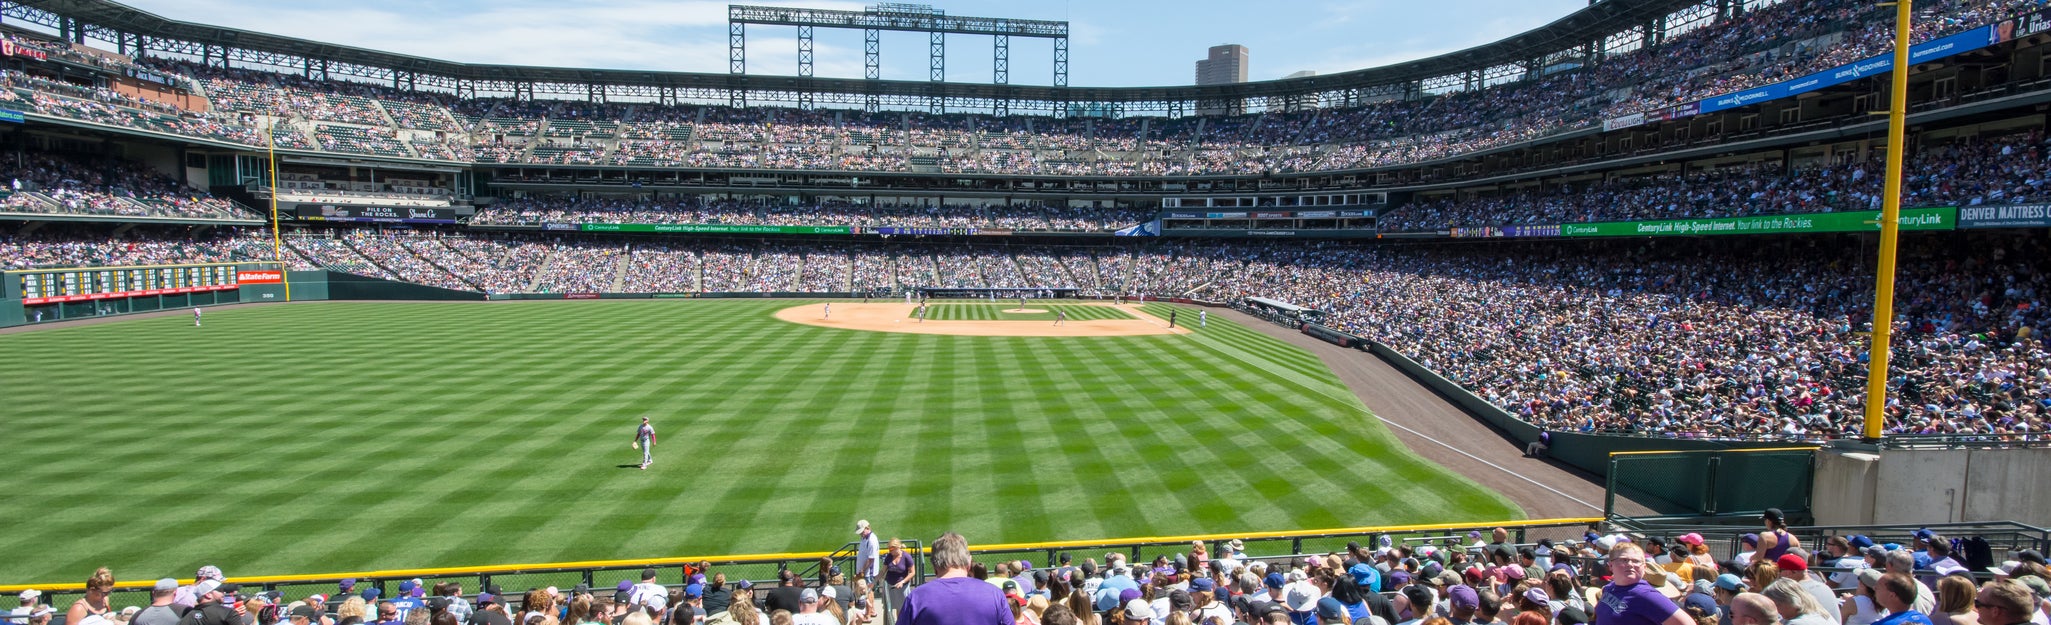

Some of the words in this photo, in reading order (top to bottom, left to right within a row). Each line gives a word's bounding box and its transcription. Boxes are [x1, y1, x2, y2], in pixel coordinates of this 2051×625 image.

[2019, 17, 2025, 29] 7
[1961, 207, 1995, 220] DENVER
[1998, 205, 2043, 219] MATTRESS
[1637, 222, 1672, 234] CenturyLink
[1673, 221, 1713, 234] High-Speed
[1737, 220, 1750, 230] Your
[1751, 219, 1762, 229] link
[1763, 219, 1770, 229] to
[1771, 218, 1782, 229] the
[1783, 217, 1812, 229] Rockies.
[1898, 213, 1941, 227] nturyLink
[1573, 225, 1598, 235] CenturyLink
